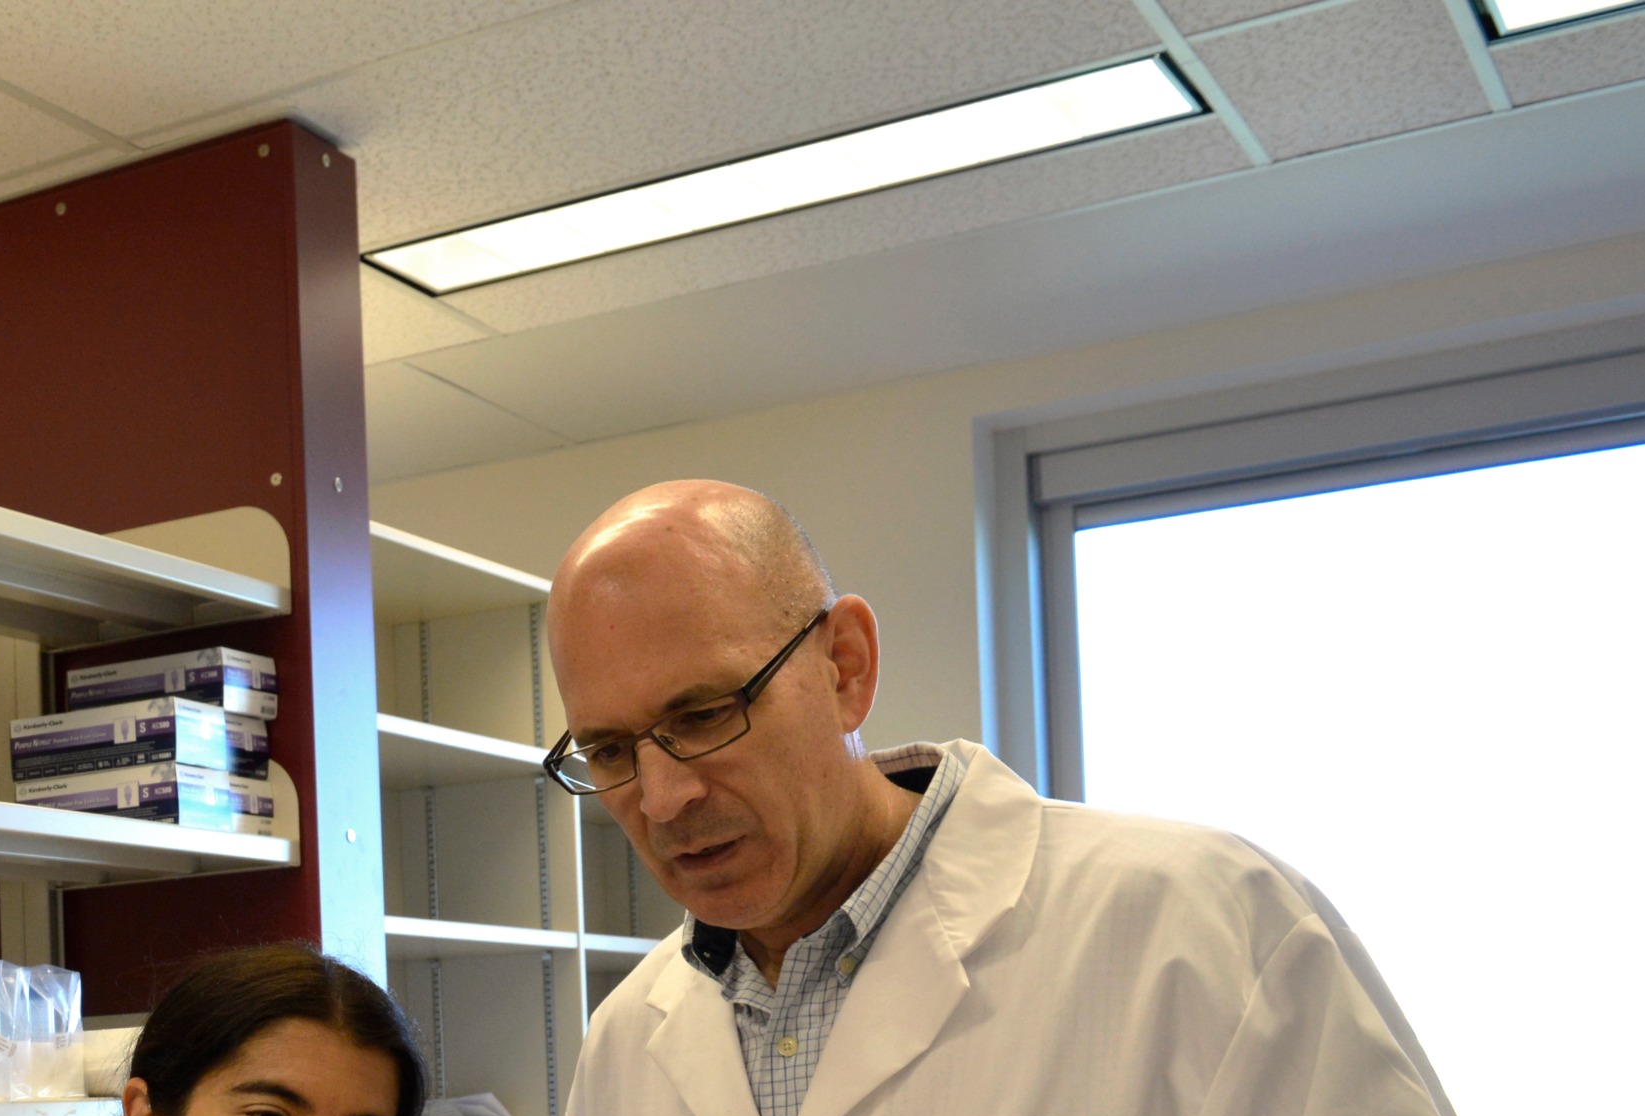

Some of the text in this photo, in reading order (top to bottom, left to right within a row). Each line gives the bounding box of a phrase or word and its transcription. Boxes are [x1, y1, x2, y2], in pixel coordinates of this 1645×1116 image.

[188, 671, 195, 683] S
[140, 722, 146, 733] S
[142, 787, 149, 798] S
